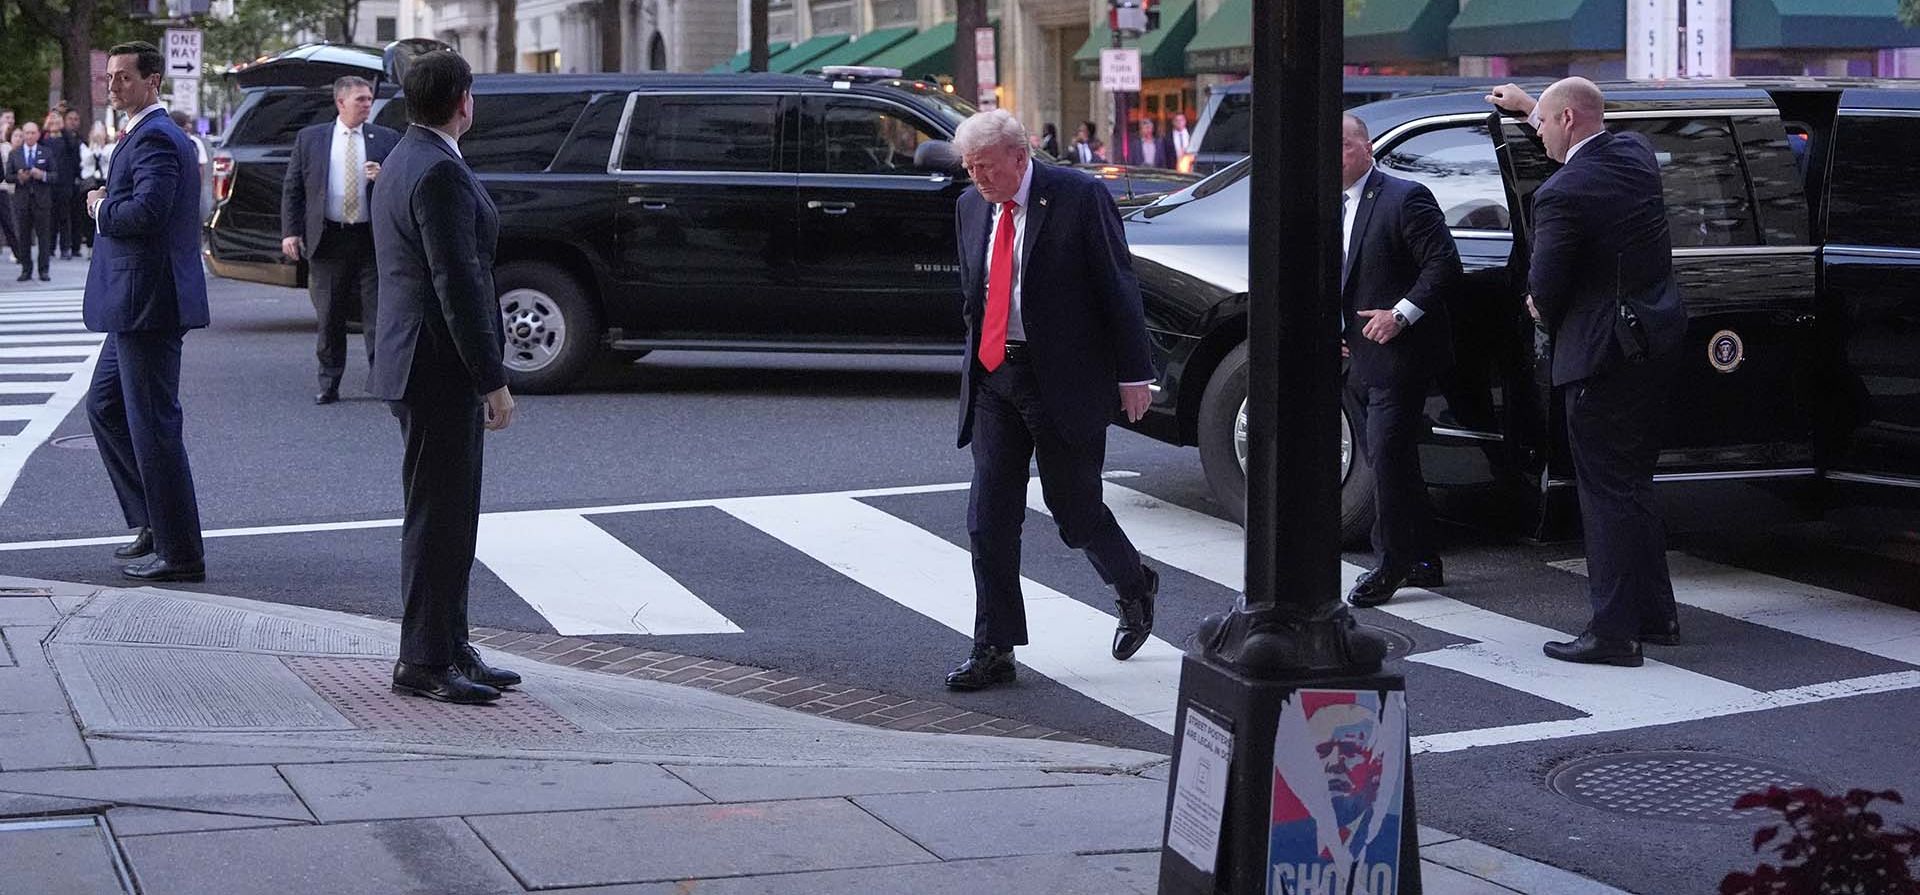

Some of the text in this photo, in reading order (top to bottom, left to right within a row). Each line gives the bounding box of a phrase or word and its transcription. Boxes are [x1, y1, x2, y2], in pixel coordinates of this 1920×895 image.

[171, 34, 198, 46] ONE
[171, 48, 198, 58] WAY
[1188, 714, 1232, 748] STREET POSTERS
[1186, 729, 1197, 741] ARE
[1198, 735, 1214, 752] LEGAL
